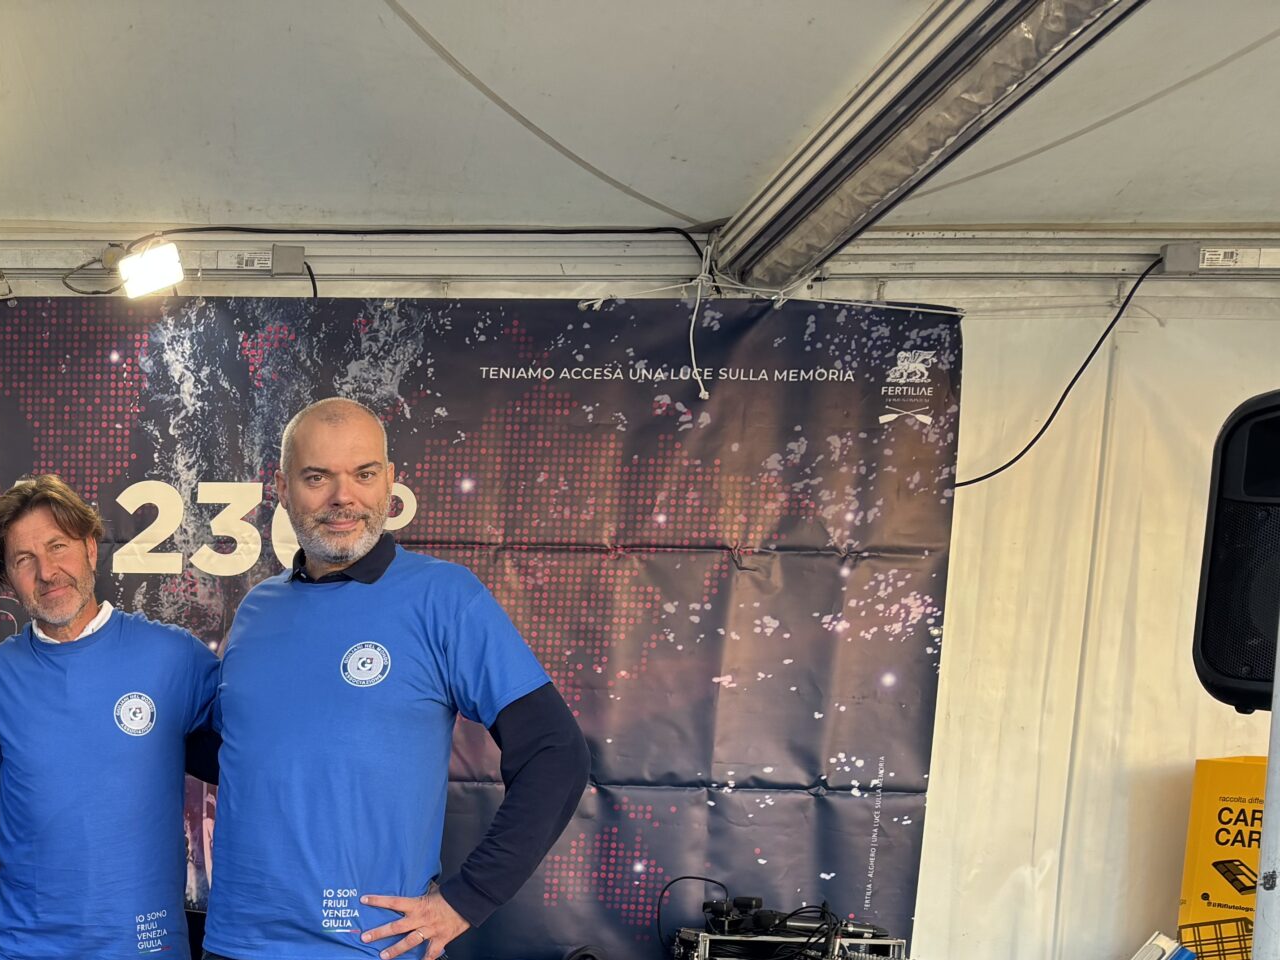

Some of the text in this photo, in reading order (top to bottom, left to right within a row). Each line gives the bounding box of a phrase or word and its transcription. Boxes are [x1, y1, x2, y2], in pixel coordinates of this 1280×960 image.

[479, 365, 856, 383] TENIAMO ACCESA UNA LUCE SULLA MEMORIA
[1218, 795, 1247, 804] raccolta
[323, 889, 335, 898] IO
[322, 899, 349, 908] FRIULI
[135, 909, 167, 923] IO SONO
[321, 908, 360, 918] VENEZIA
[321, 919, 353, 928] GIULIA
[136, 928, 168, 941] VENEZIA
[137, 938, 163, 950] GIULIA
